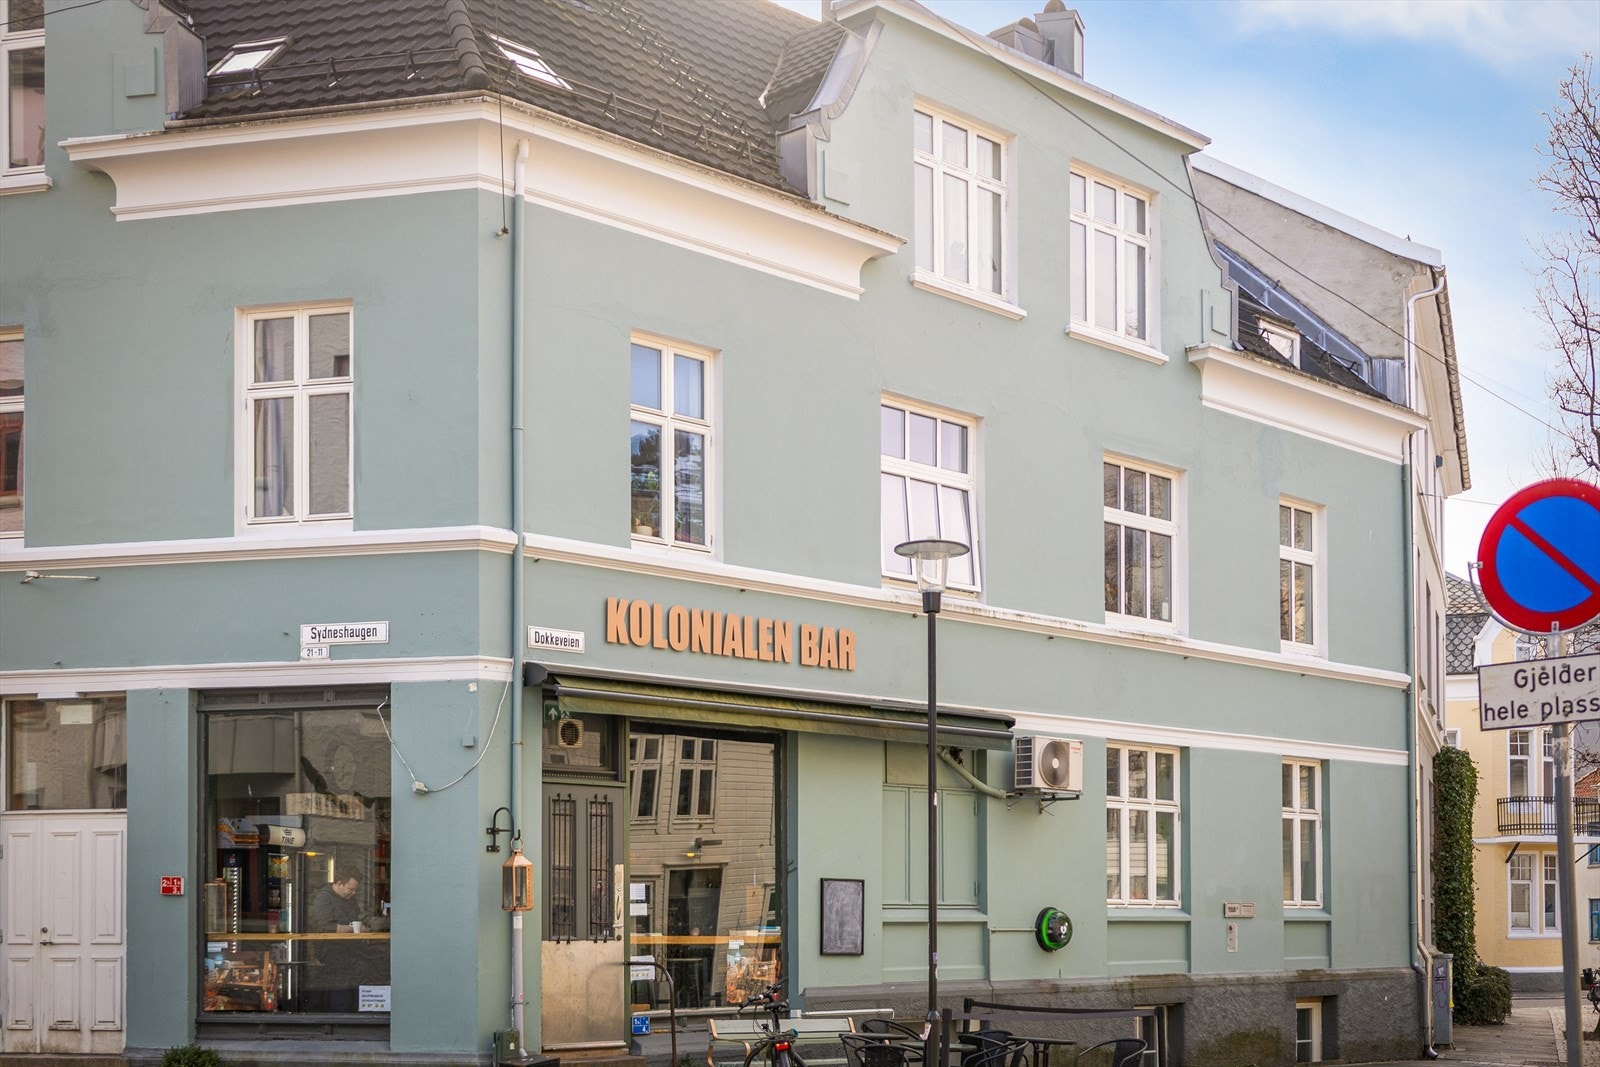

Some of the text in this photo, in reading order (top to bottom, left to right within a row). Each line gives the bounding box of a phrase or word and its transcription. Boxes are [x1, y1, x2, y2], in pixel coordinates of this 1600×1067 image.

[310, 625, 378, 642] Sydneshaugen
[534, 630, 580, 648] Dokkeveien
[606, 596, 857, 671] KOLONIALEN BAR
[1514, 662, 1597, 692] Gjelder
[1484, 696, 1600, 721] hele plass
